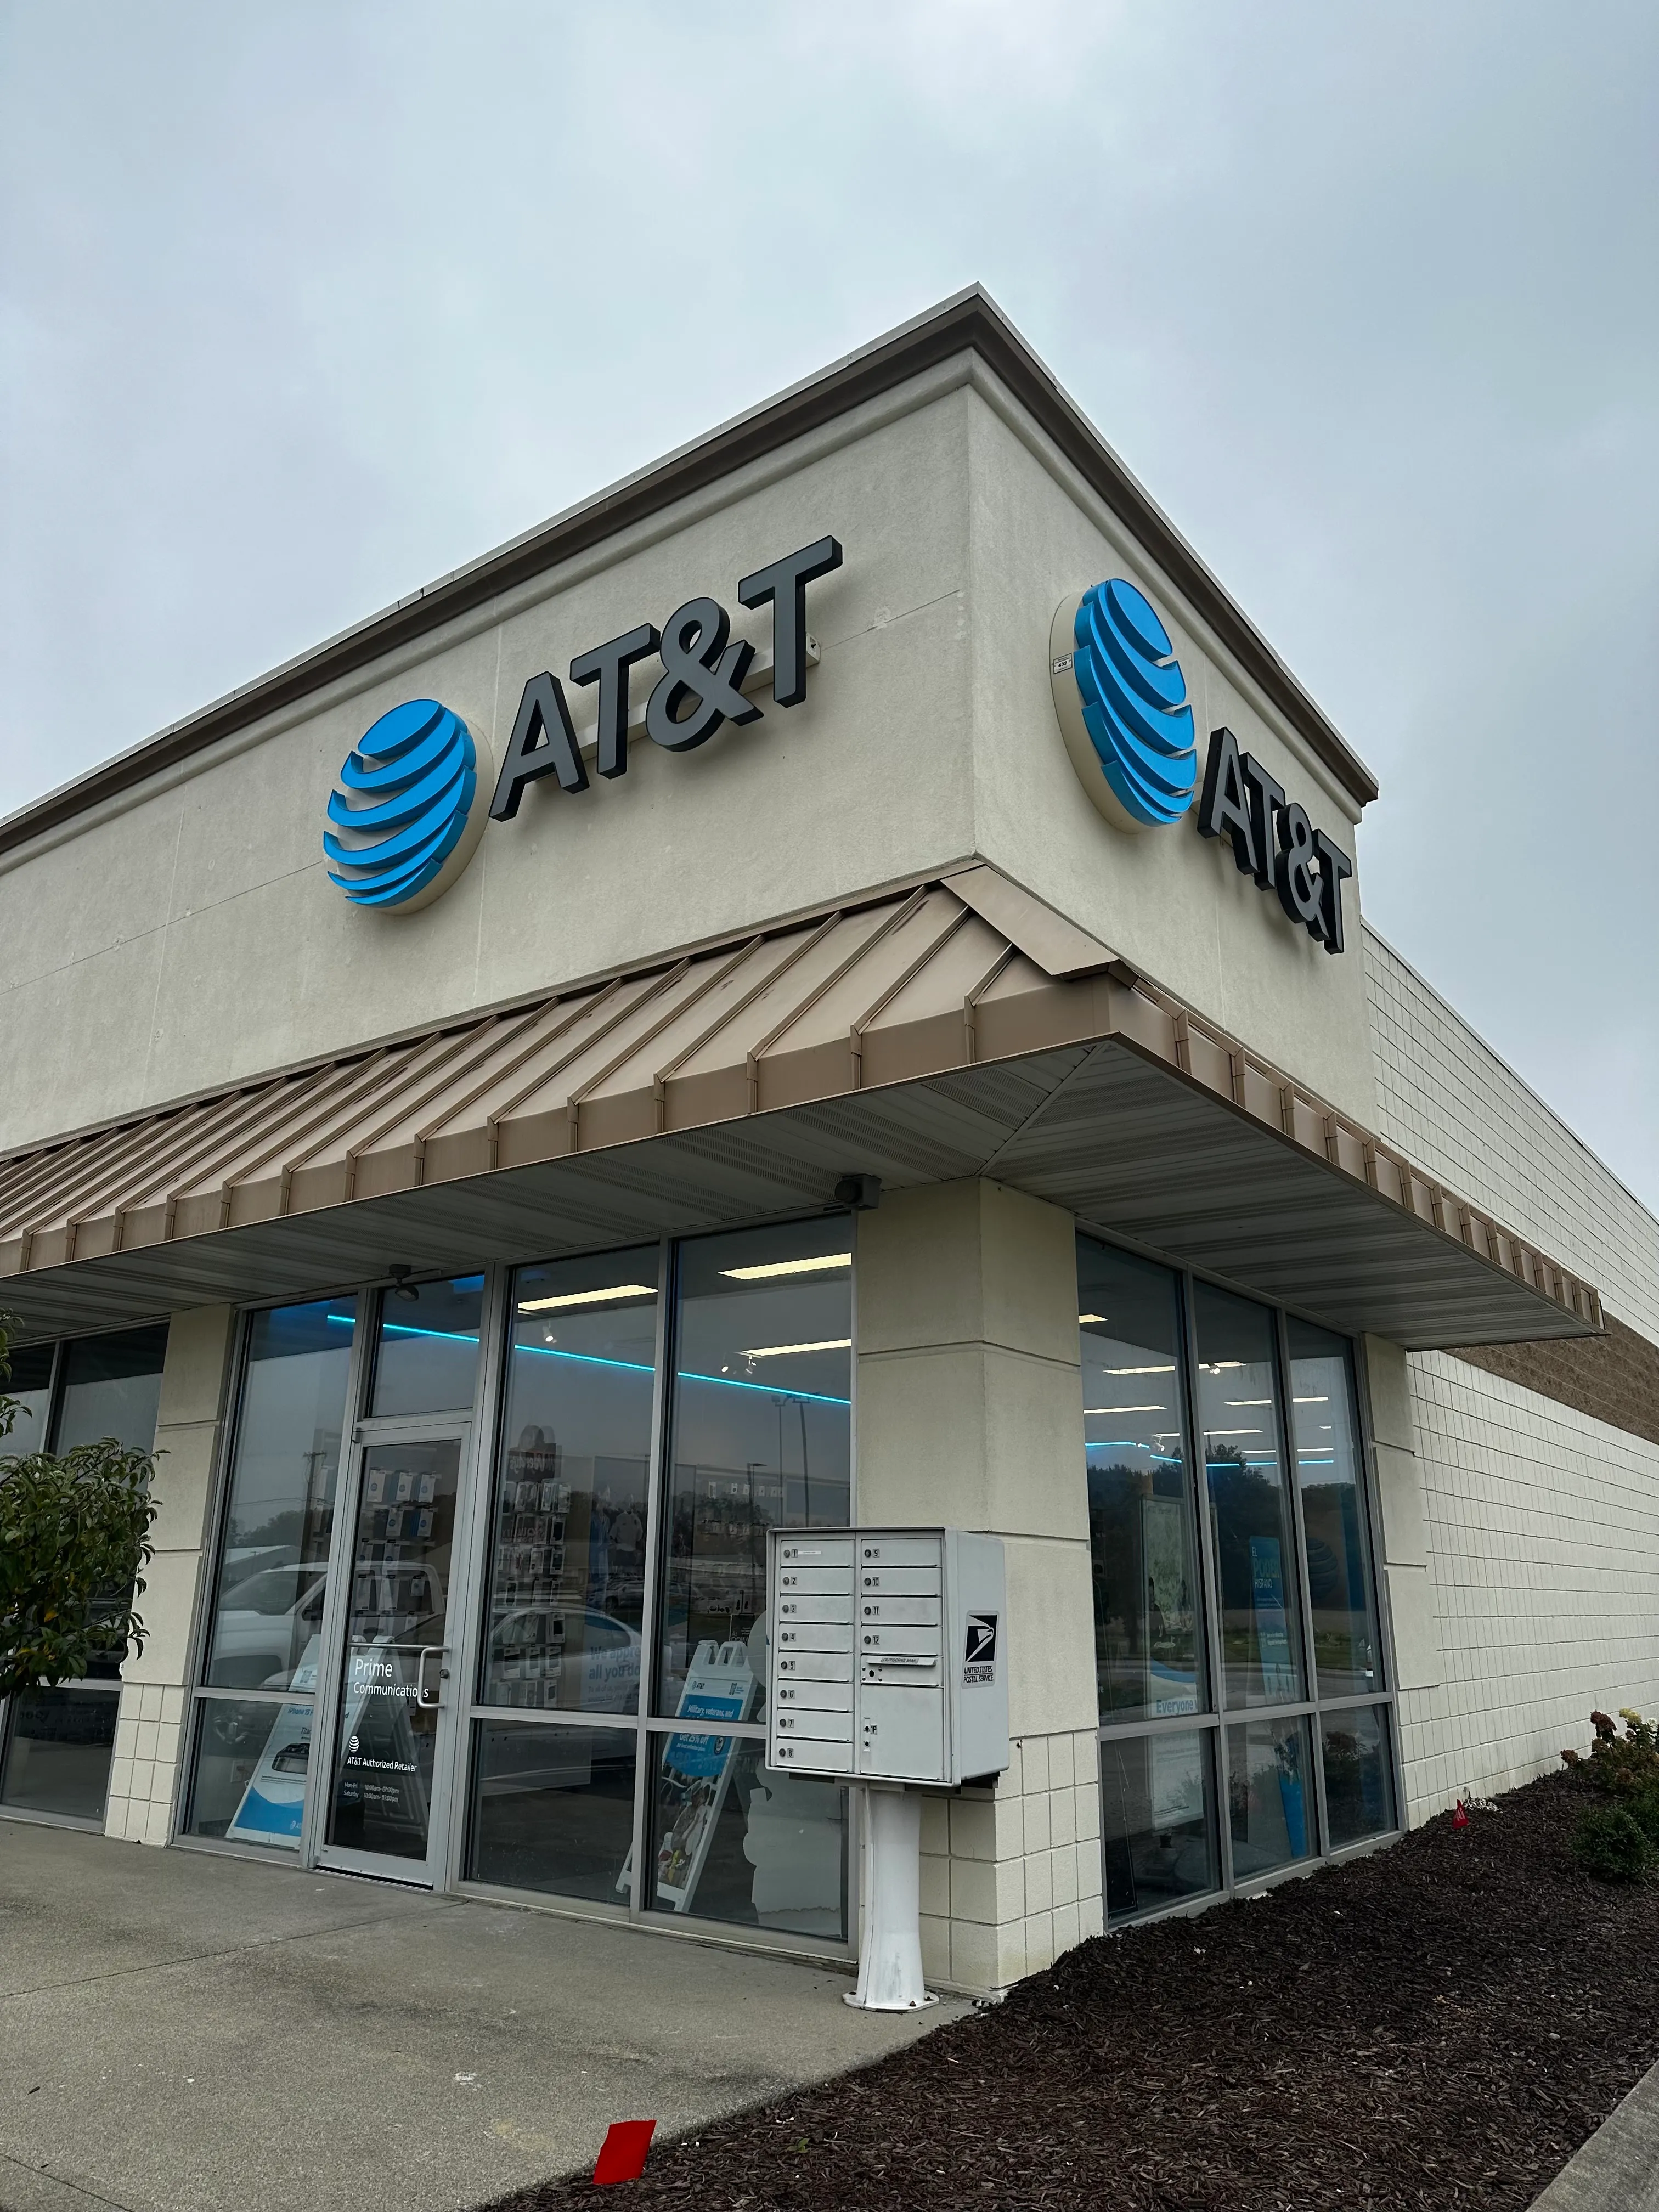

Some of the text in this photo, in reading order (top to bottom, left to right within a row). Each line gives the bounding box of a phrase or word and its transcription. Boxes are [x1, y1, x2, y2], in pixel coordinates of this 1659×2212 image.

[489, 535, 842, 822] AT&T
[1197, 727, 1352, 954] AT&T
[355, 1658, 393, 1677] Prime
[589, 1664, 602, 1679] all
[604, 1666, 624, 1682] you
[354, 1681, 429, 1698] Communicatios
[1156, 1699, 1194, 1715] Everyone
[871, 1725, 877, 1734] 1P
[347, 1757, 417, 1772] AT&T Authorized Retailer
[343, 1790, 359, 1799] Saturday
